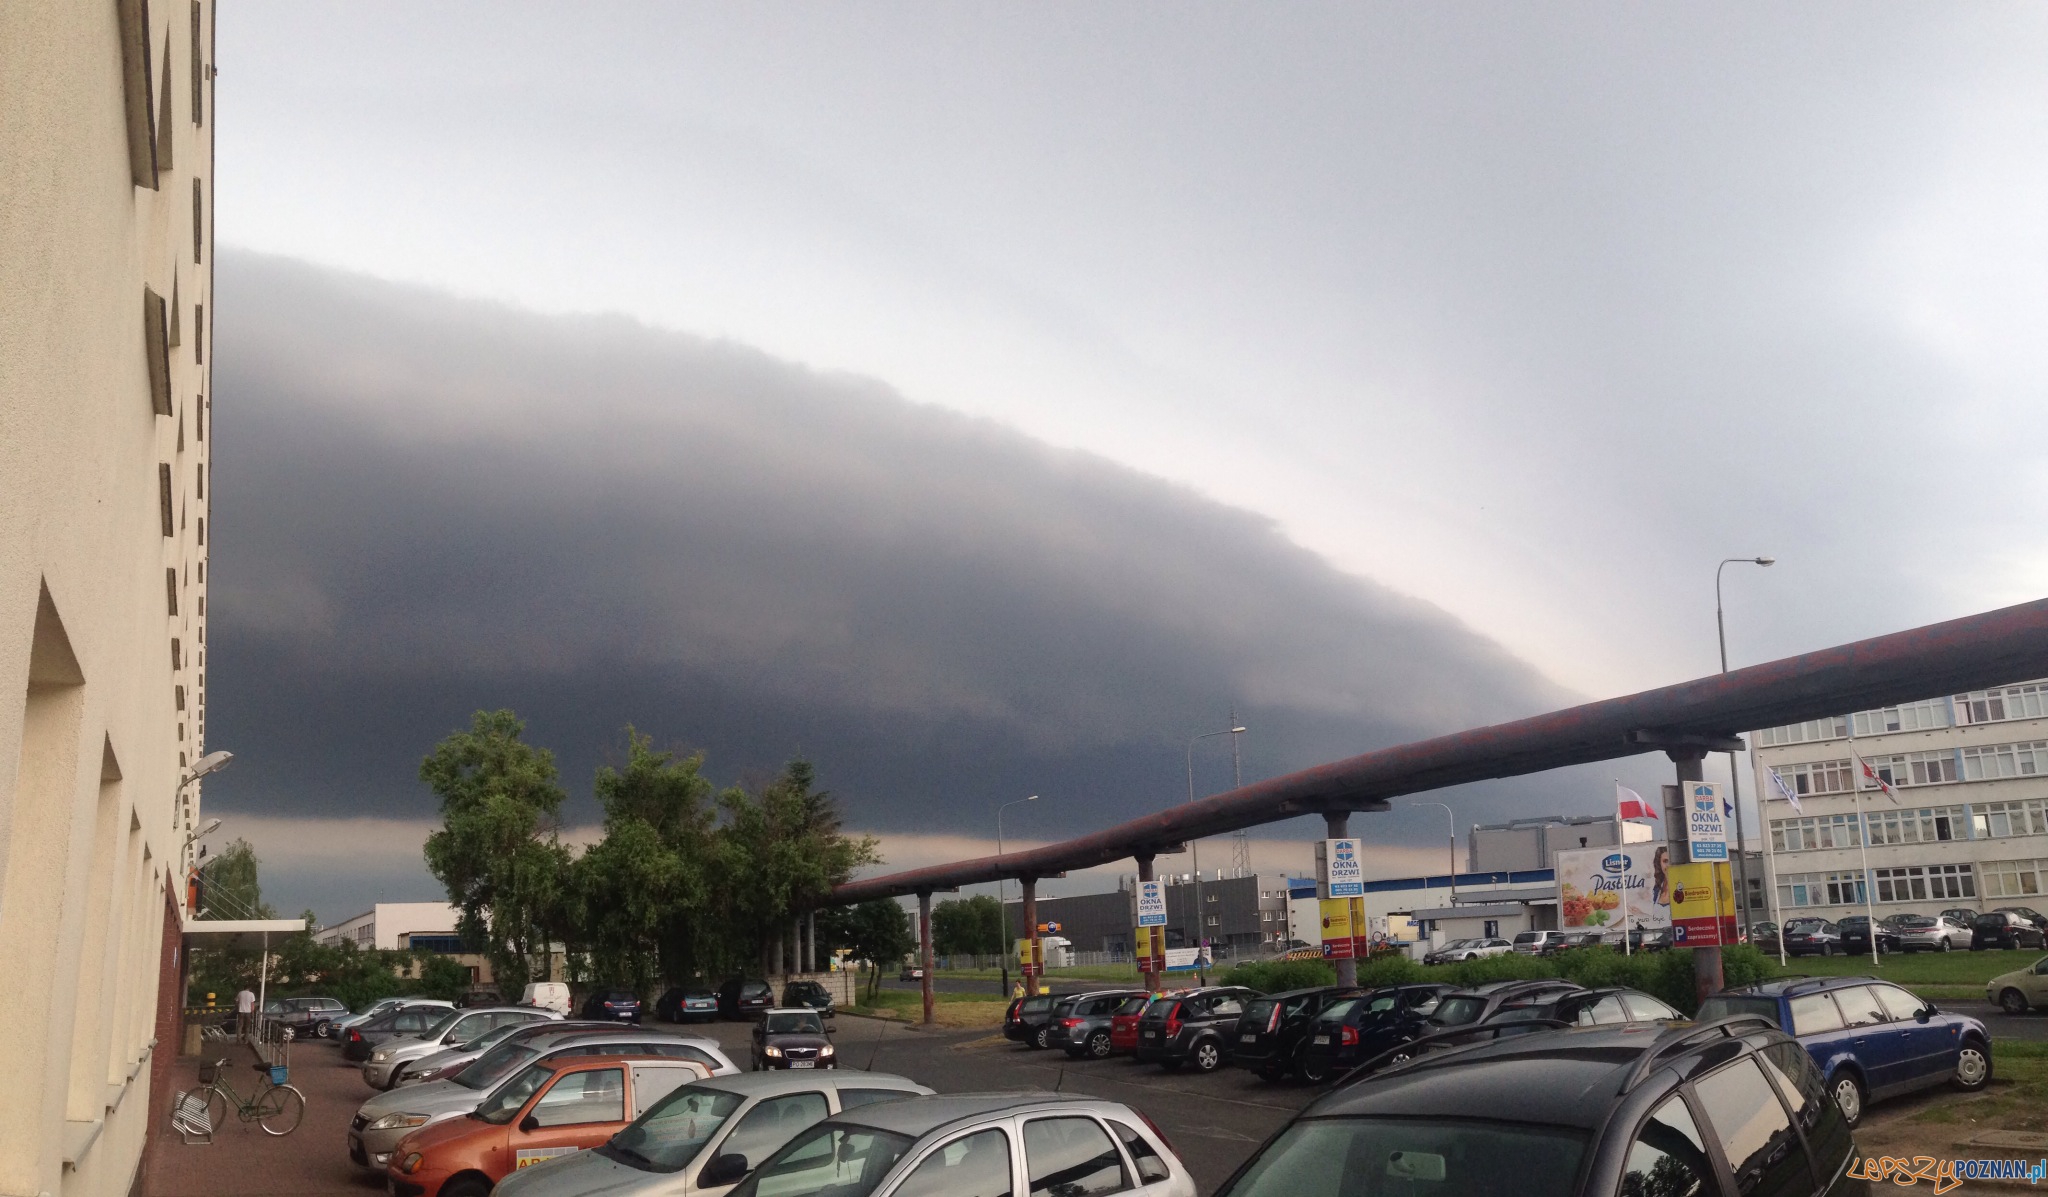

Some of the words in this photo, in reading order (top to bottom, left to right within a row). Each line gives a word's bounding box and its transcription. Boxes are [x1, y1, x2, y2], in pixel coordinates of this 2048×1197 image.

[1692, 812, 1720, 823] OKNA
[1691, 824, 1722, 833] DRZWI
[1675, 926, 1685, 941] P
[1687, 933, 1718, 941] zapraszamy!
[1324, 944, 1331, 955] P
